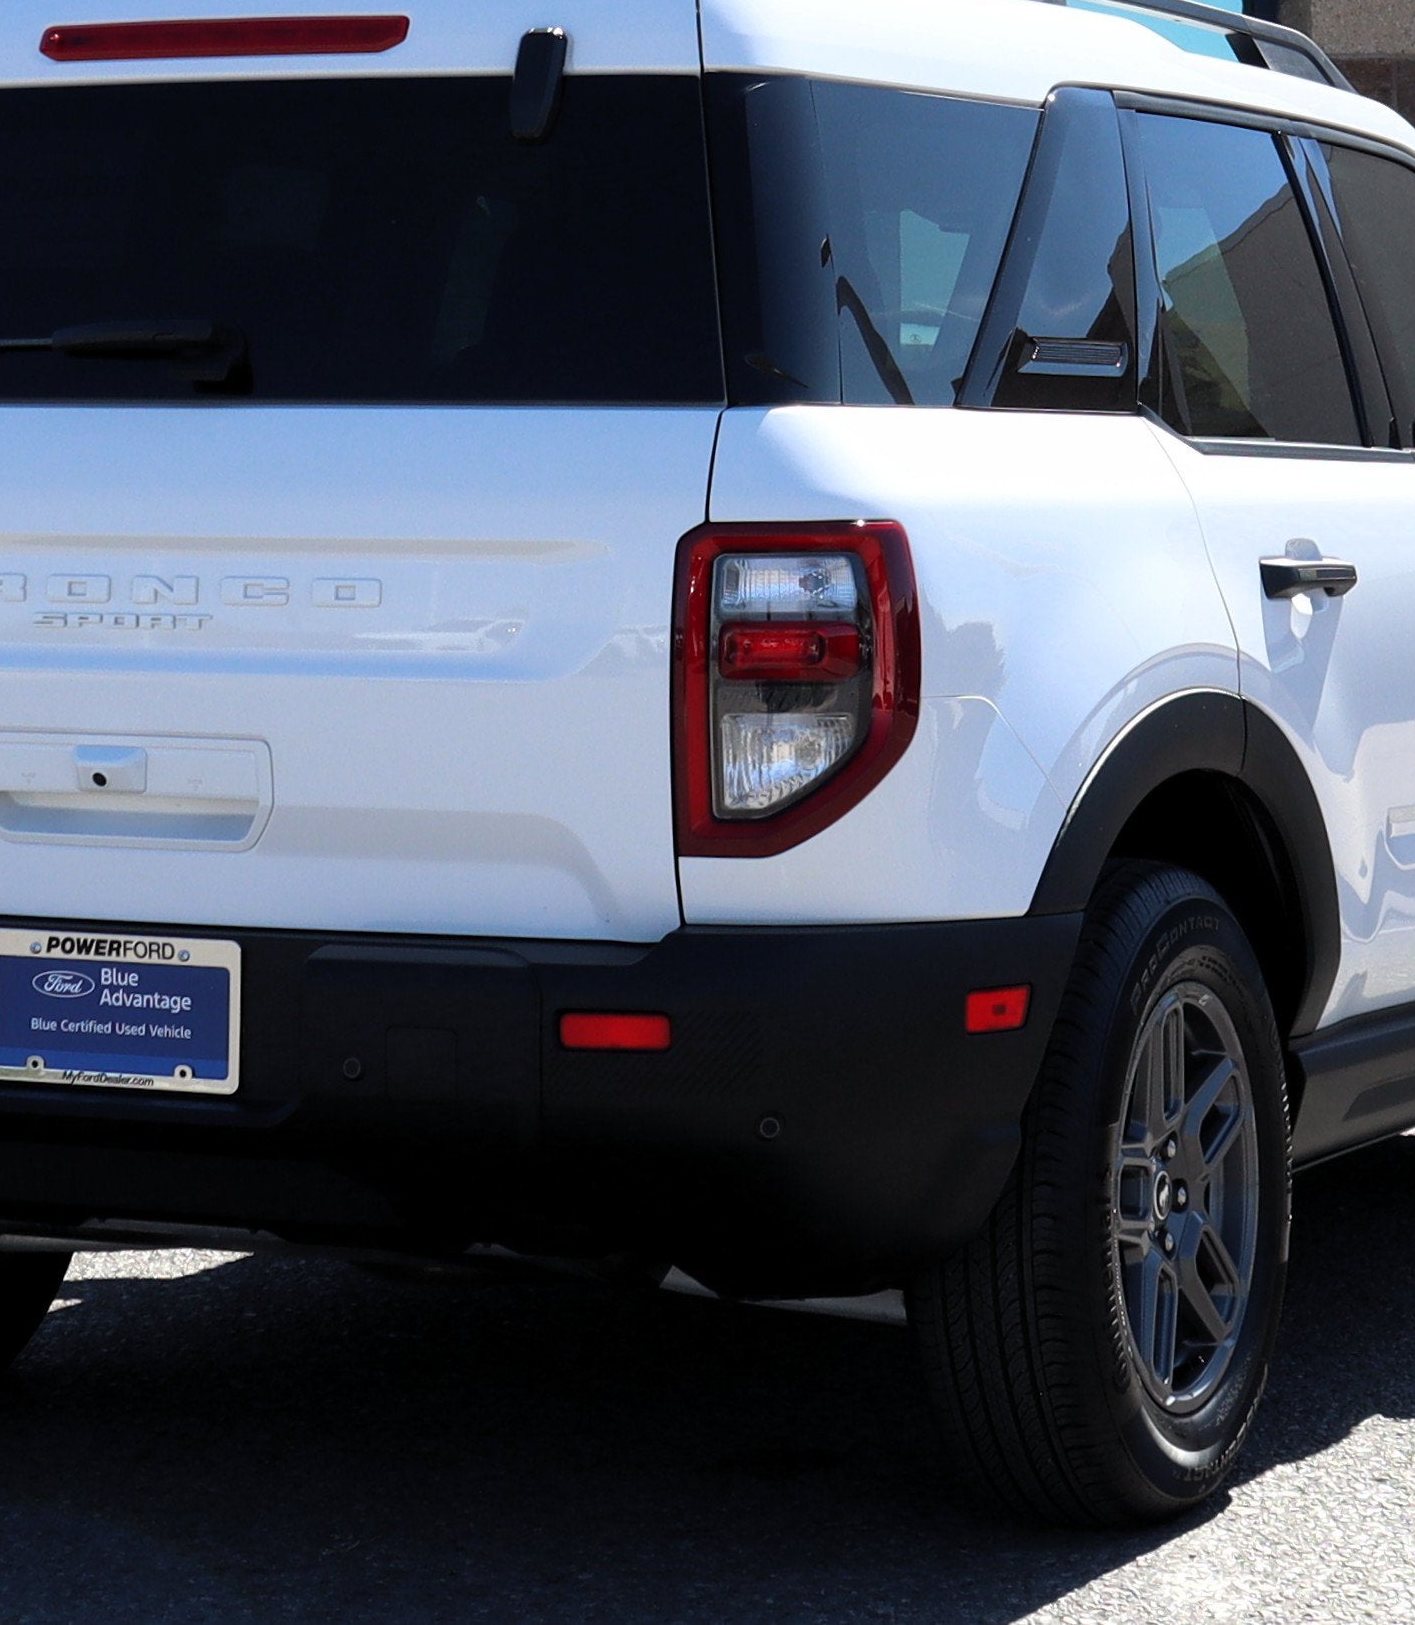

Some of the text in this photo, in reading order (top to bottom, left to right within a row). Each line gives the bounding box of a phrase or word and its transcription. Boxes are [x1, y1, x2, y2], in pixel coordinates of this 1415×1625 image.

[32, 611, 214, 631] SPORT
[45, 936, 176, 960] POWERFORD
[43, 973, 84, 994] Ford
[100, 967, 139, 987] Blue
[99, 988, 192, 1014] Advantage
[30, 1017, 192, 1040] Blue Certified Used Vehicle
